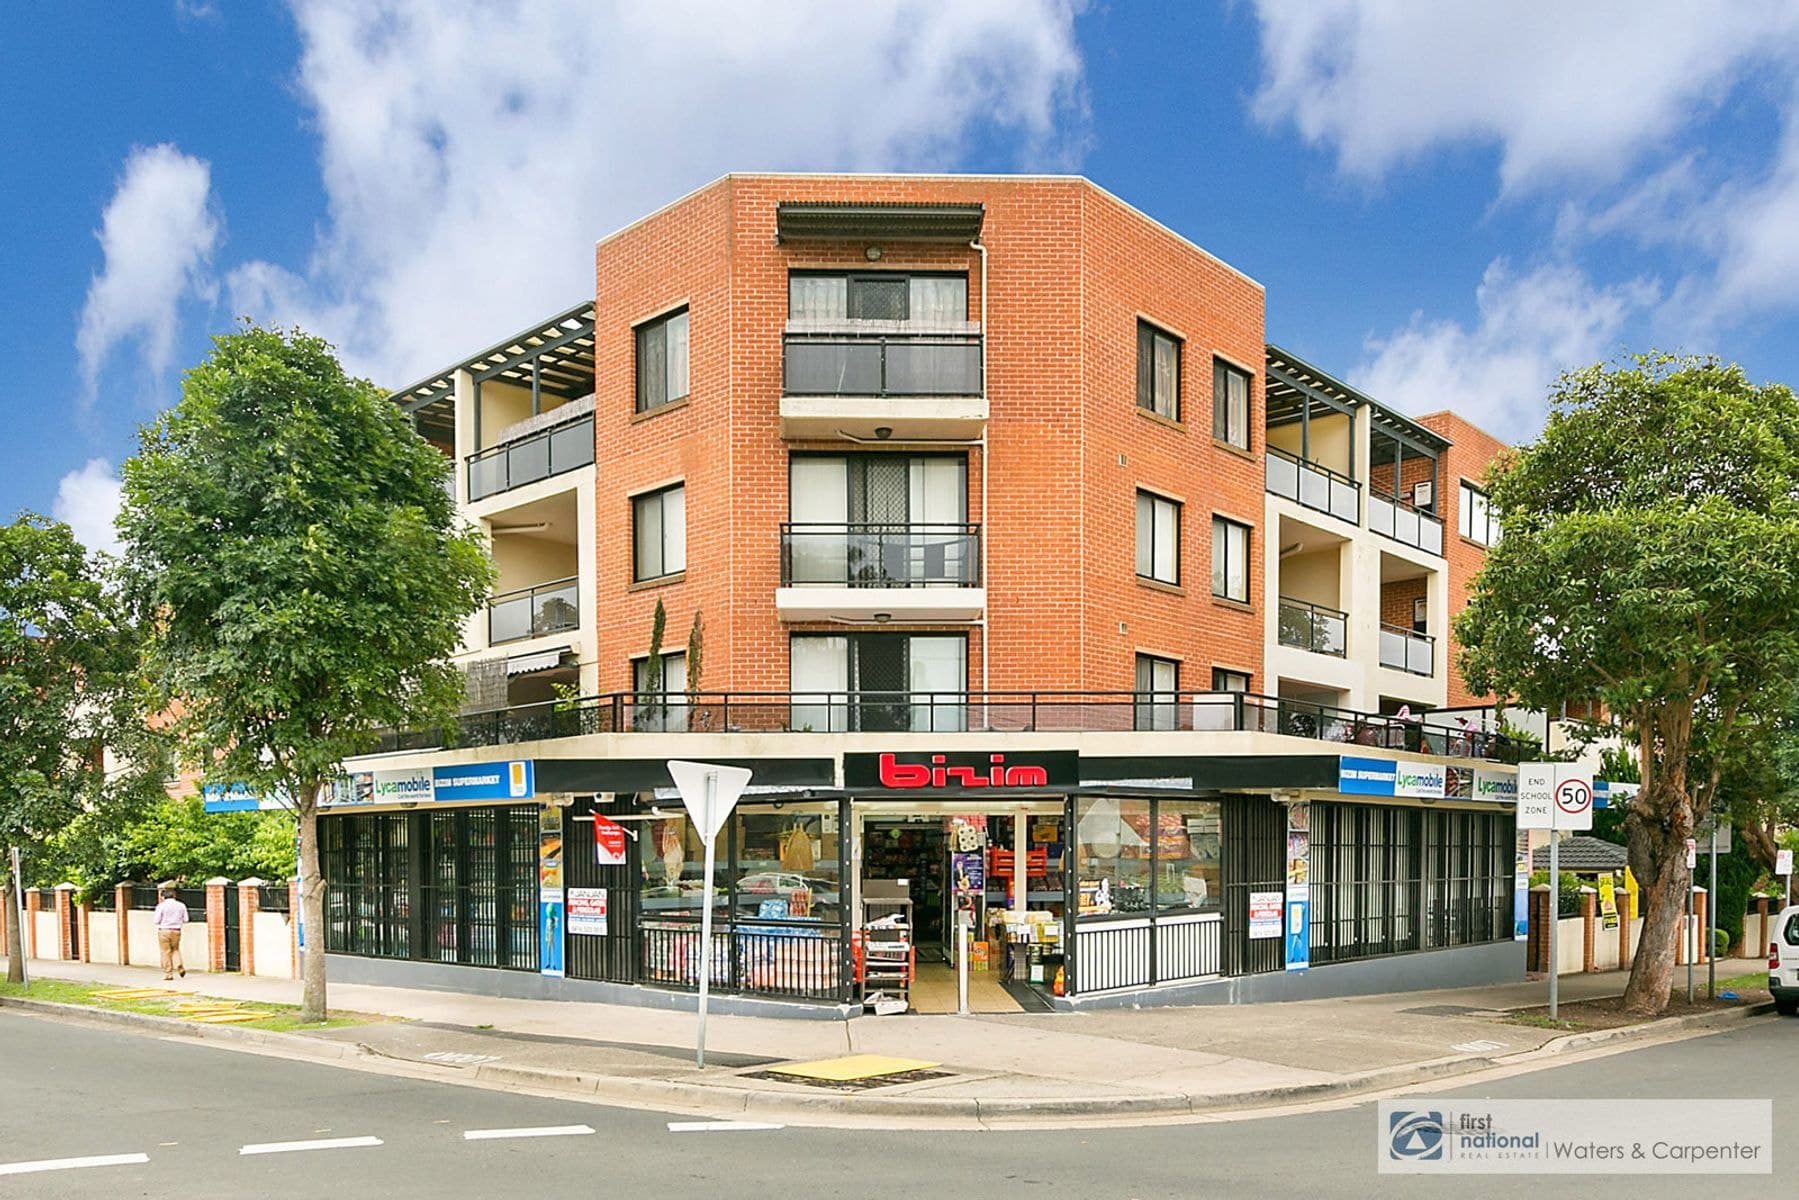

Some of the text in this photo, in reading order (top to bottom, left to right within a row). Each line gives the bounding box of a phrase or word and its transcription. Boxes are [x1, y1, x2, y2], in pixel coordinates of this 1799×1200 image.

[375, 776, 431, 796] Lycamobile
[1397, 771, 1443, 789] Lycamobile
[1478, 777, 1517, 795] Lycamobil
[1528, 778, 1546, 786] END
[1520, 792, 1553, 800] SCHOOL
[1562, 787, 1587, 805] 50
[1524, 807, 1547, 815] ZONE
